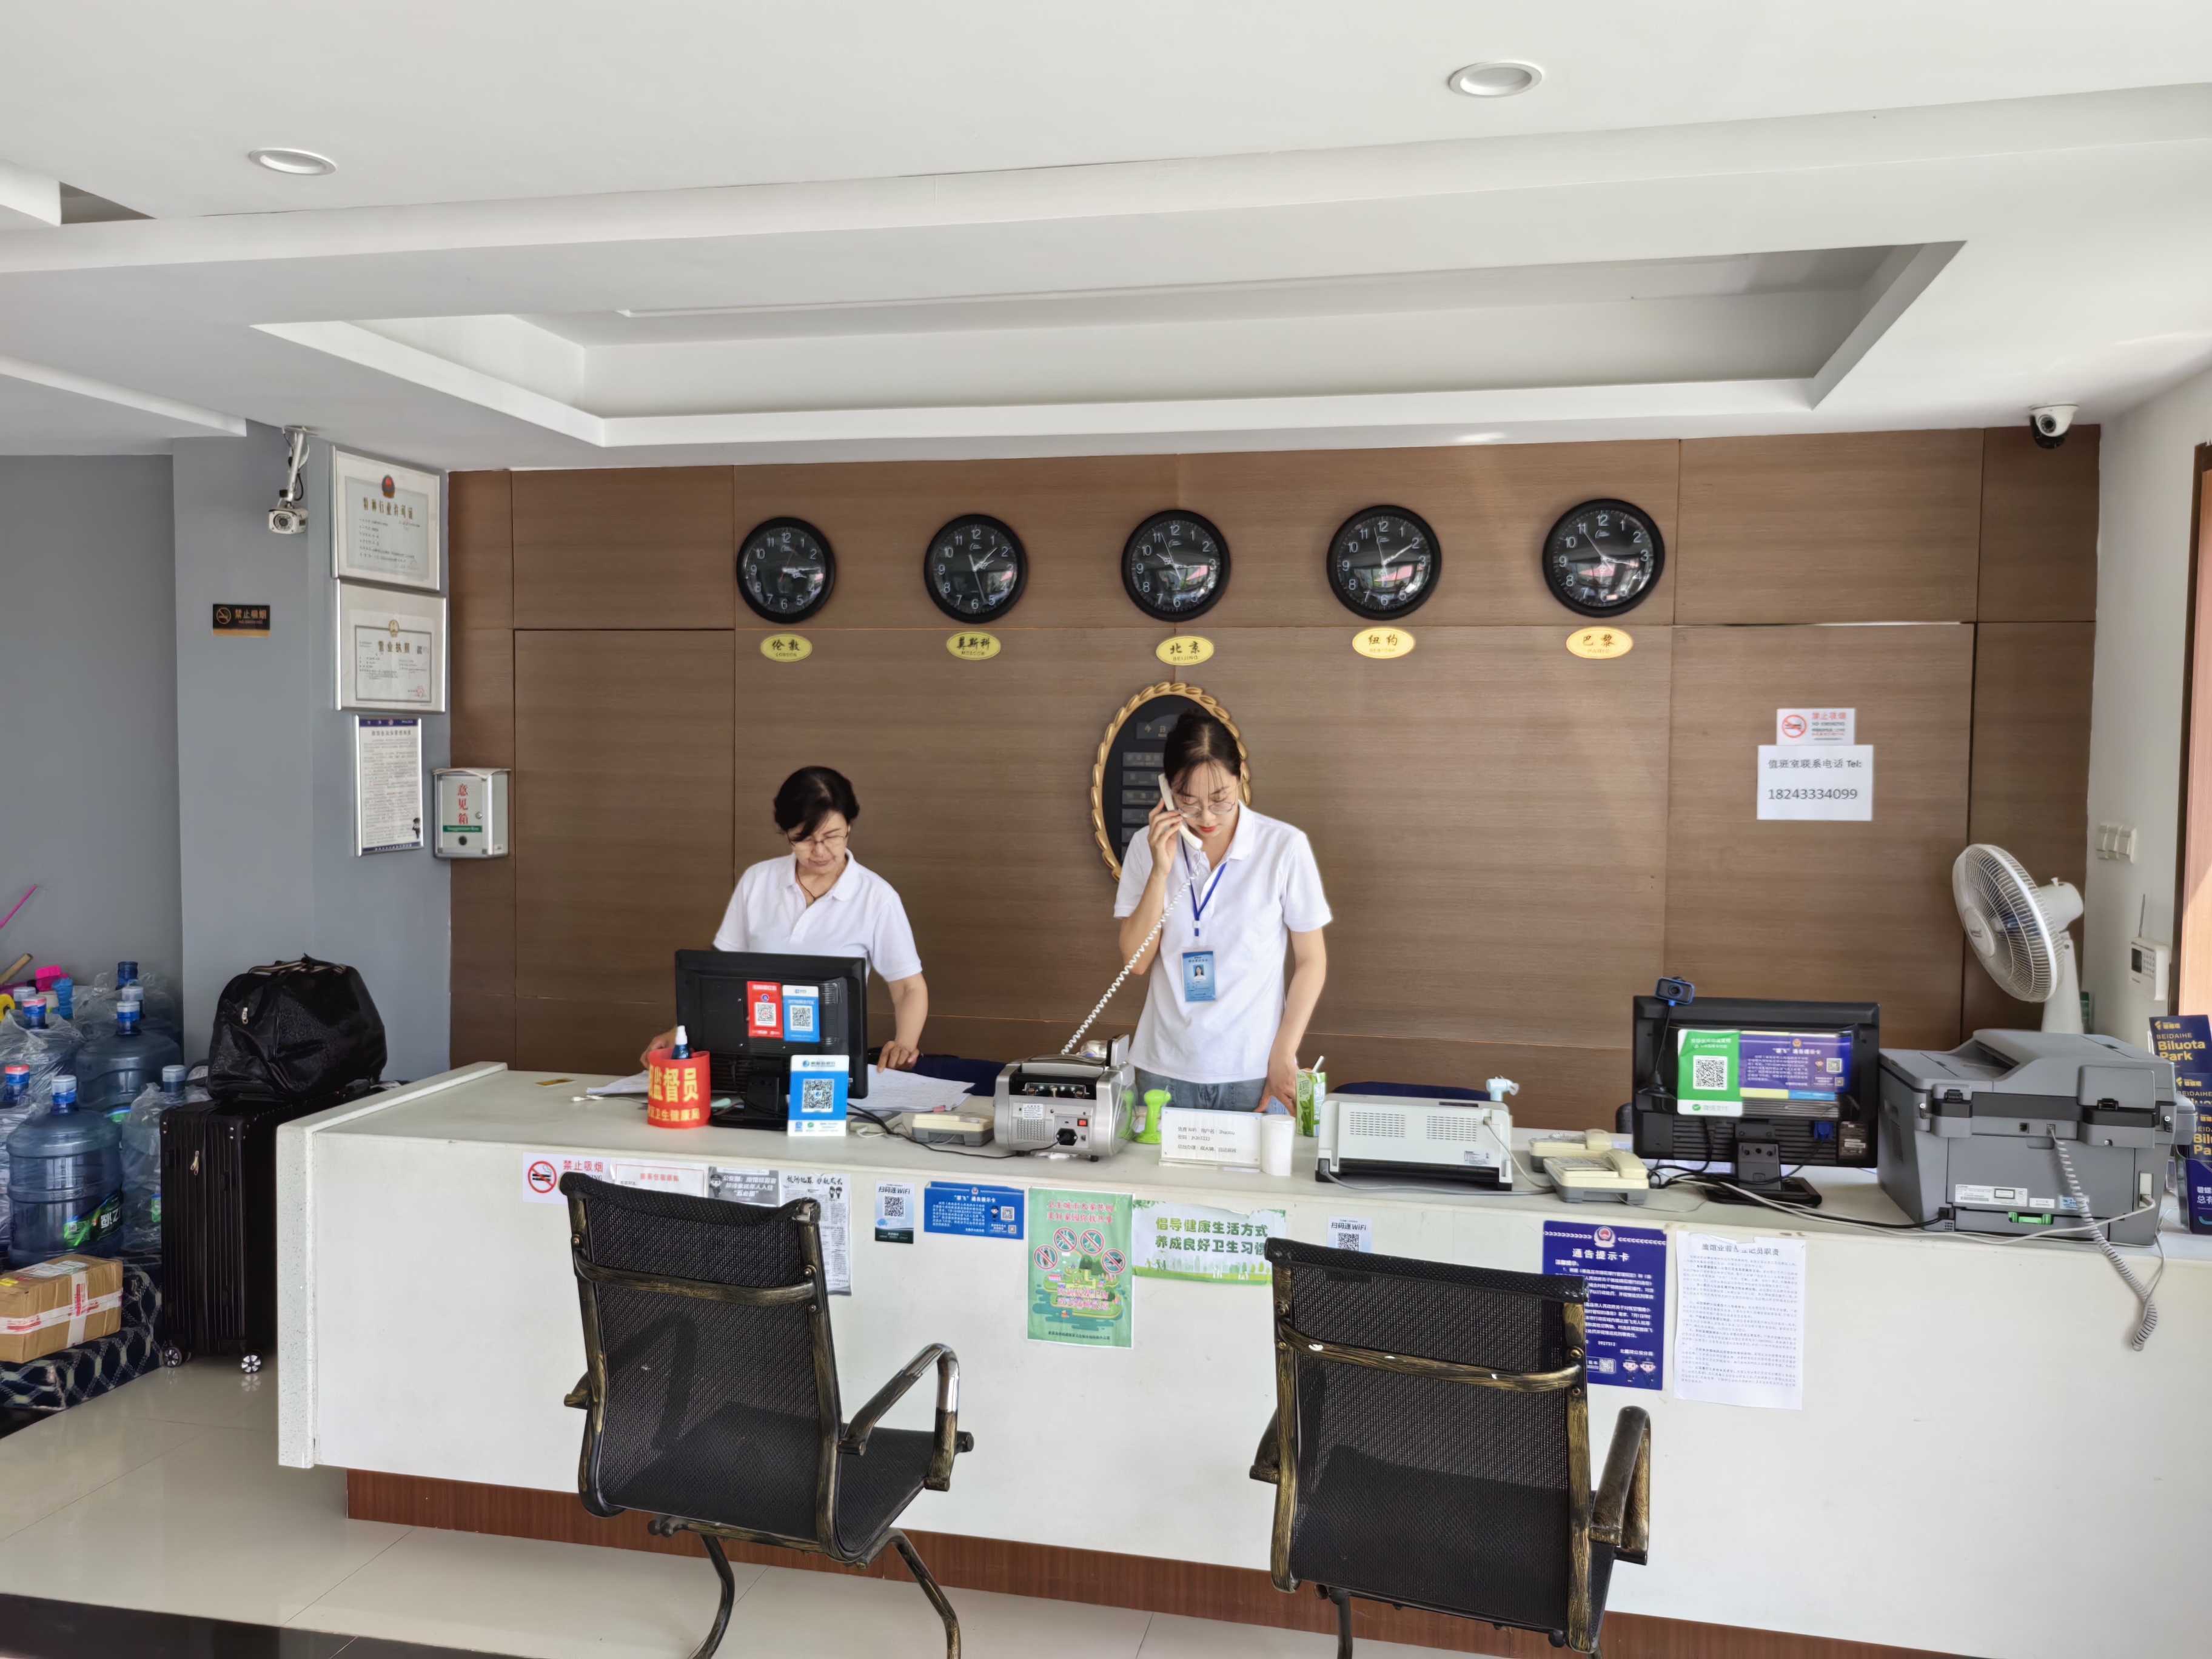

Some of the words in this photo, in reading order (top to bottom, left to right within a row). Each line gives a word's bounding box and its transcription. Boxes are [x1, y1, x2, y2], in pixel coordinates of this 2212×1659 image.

[1597, 515, 1609, 526] 12
[1620, 520, 1625, 531] 1
[1170, 525, 1179, 535] 12
[1378, 521, 1388, 532] 12
[1578, 523, 1586, 533] 11
[971, 529, 980, 539] 12
[1191, 530, 1195, 540] 1
[1360, 529, 1367, 540] 11
[1399, 527, 1404, 537] 1
[767, 538, 774, 547] 11
[782, 533, 791, 543] 12
[801, 538, 804, 547] 1
[956, 536, 963, 545] 11
[991, 536, 994, 545] 1
[1153, 533, 1161, 543] 11
[1566, 537, 1575, 548] 10
[1634, 532, 1641, 543] 2
[1202, 541, 1209, 552] 2
[1349, 542, 1358, 552] 10
[1412, 538, 1419, 549] 2
[756, 549, 765, 559] 10
[811, 550, 817, 559] 2
[944, 548, 954, 558] 10
[1002, 547, 1008, 557] 2
[1142, 546, 1151, 555] 10
[1641, 550, 1649, 561] 3
[1209, 559, 1215, 569] 3
[1342, 561, 1350, 571] 9
[1419, 556, 1425, 567] 3
[1559, 555, 1567, 567] 9
[751, 565, 757, 575] 9
[939, 565, 945, 575] 9
[1137, 564, 1144, 574] 9
[1566, 575, 1574, 586] 8
[1632, 571, 1641, 581] 4
[754, 582, 761, 592] 8
[944, 583, 950, 593] 8
[1143, 582, 1150, 592] 8
[1349, 580, 1356, 590] 8
[1364, 591, 1371, 602] 7
[1581, 588, 1589, 599] 7
[768, 594, 773, 604] 7
[797, 596, 803, 605] 5
[957, 595, 962, 605] 7
[971, 599, 979, 609] 6
[989, 595, 994, 605] 5
[1157, 594, 1163, 604] 7
[1174, 597, 1181, 607] 6
[1381, 595, 1388, 605] 6
[782, 600, 788, 609] 6
[772, 639, 801, 651] 伦敦
[957, 637, 990, 649] 莫斯科
[1368, 634, 1398, 646] 纽约
[1583, 634, 1615, 648] 巴黎
[1170, 641, 1200, 654] 北京
[1768, 759, 1843, 769] 值班室联系电话
[1846, 760, 1862, 768] Tel:
[1768, 788, 1858, 800] 18243334099
[458, 783, 468, 825] 意见箱
[2157, 1040, 2205, 1051] Biluota
[2159, 1051, 2193, 1061] Park
[563, 1160, 603, 1173] 禁止吸烟
[1156, 1217, 1268, 1237] 倡导健康生活方式
[1155, 1235, 1265, 1255] 养成良好卫生习惯
[1572, 1248, 1630, 1262] 通告提示卡
